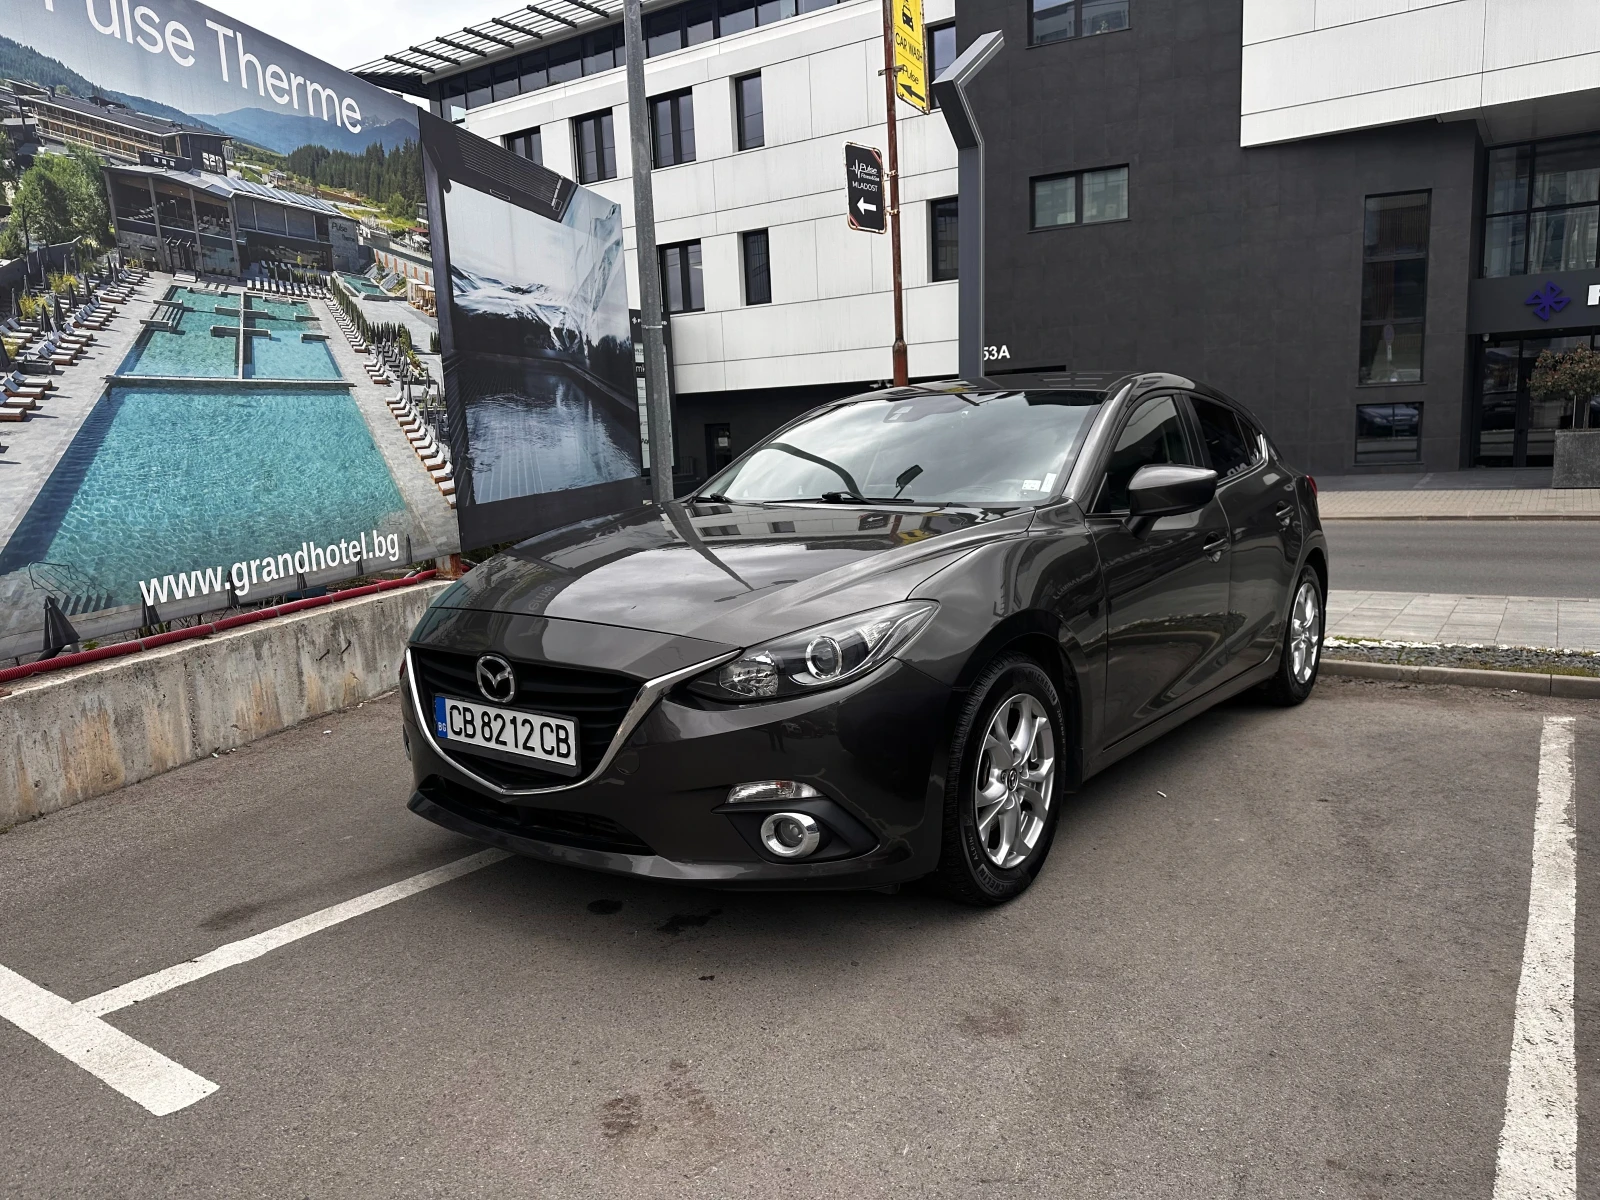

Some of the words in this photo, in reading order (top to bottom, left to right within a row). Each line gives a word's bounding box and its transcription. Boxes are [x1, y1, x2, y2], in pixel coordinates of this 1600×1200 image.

[895, 32, 908, 51] CAR
[908, 42, 923, 62] WASH
[45, 0, 195, 67] ulse
[205, 19, 362, 134] Therme
[902, 64, 919, 85] Pulse
[852, 181, 878, 192] MLADOST
[139, 531, 399, 606] www.grandhotel.bg
[437, 721, 447, 732] BG
